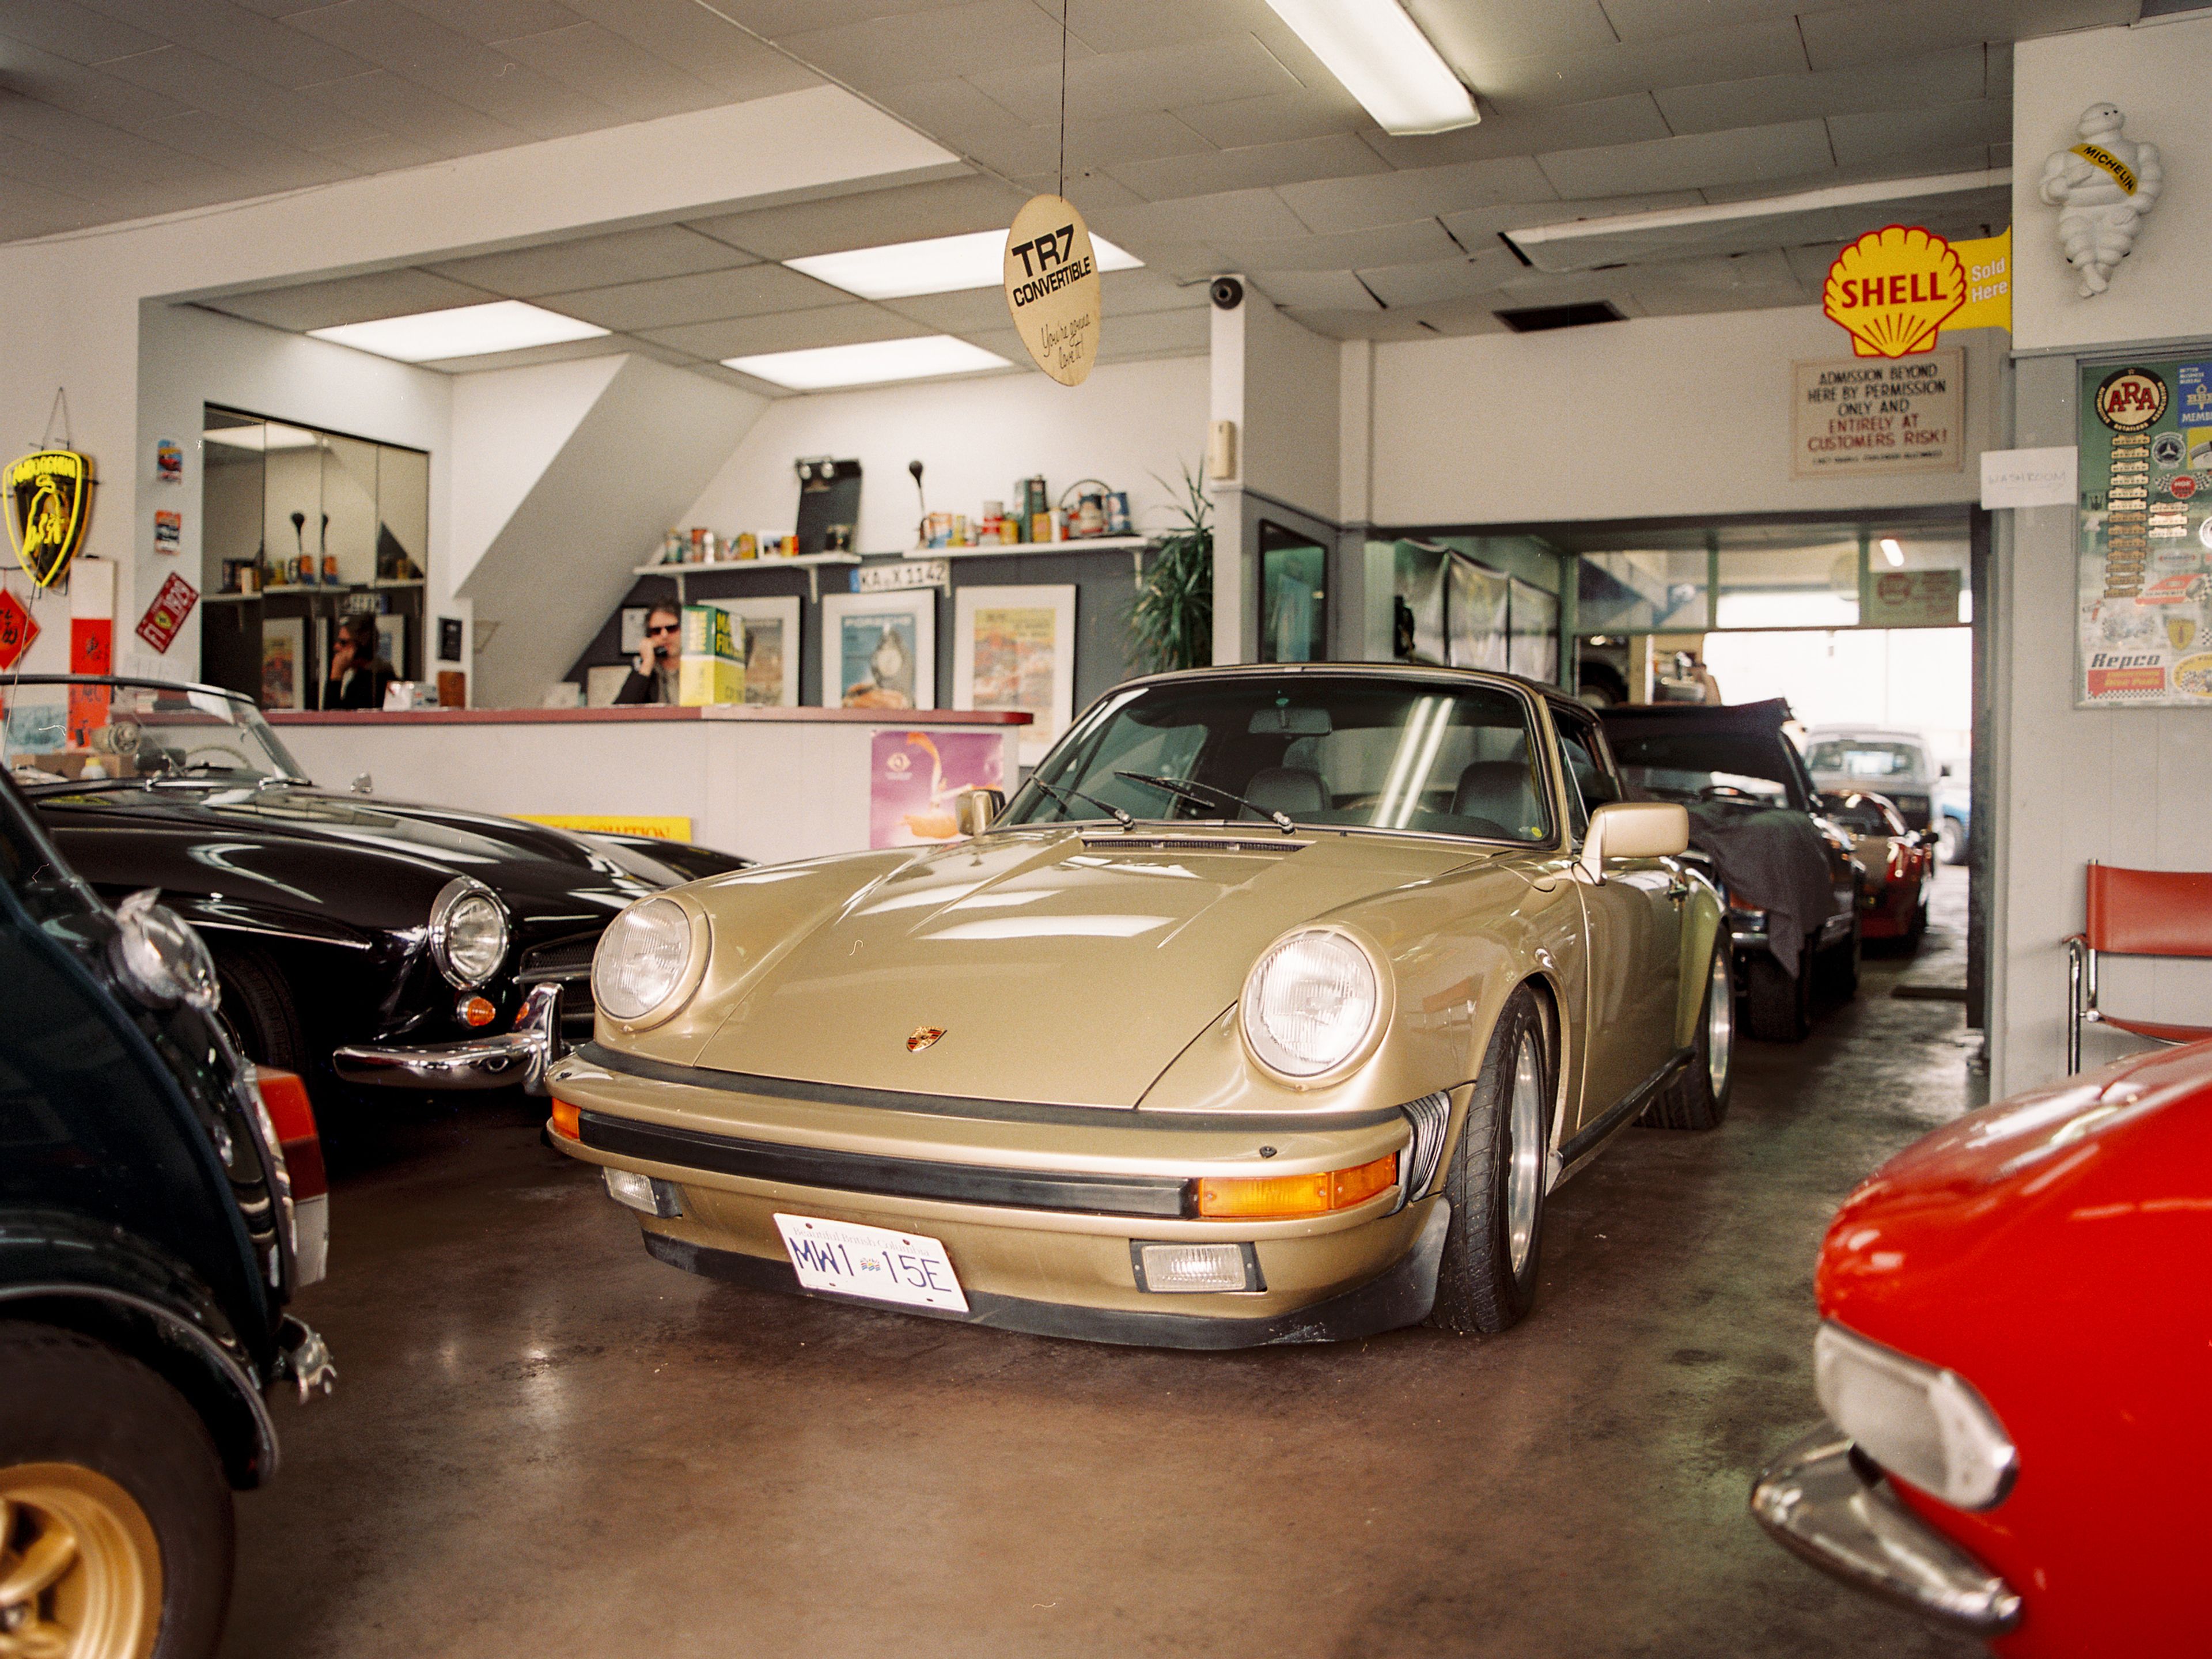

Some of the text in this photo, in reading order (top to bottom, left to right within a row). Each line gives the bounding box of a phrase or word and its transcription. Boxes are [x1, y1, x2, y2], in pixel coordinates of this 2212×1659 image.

[2084, 146, 2134, 191] MICHELIN
[1012, 224, 1074, 278] TR7
[1013, 256, 1091, 307] CONVERTIBLE
[1971, 256, 2005, 282] Sold
[1842, 272, 1948, 308] SHELL
[1971, 281, 2008, 304] Here
[1820, 363, 1938, 385] ADMISSION BEYOND
[1807, 379, 1946, 403] HERE BY PERMISSION
[2108, 381, 2156, 412] ARA
[1838, 399, 1910, 416] ONLY AND
[1829, 413, 1919, 433] ENTIRELY AT
[1807, 428, 1947, 452] CUSTOMERS RISK!
[2092, 653, 2160, 669] Repco
[793, 1227, 930, 1256] Beautiful British Columbia
[789, 1237, 952, 1293] MW1 15E
